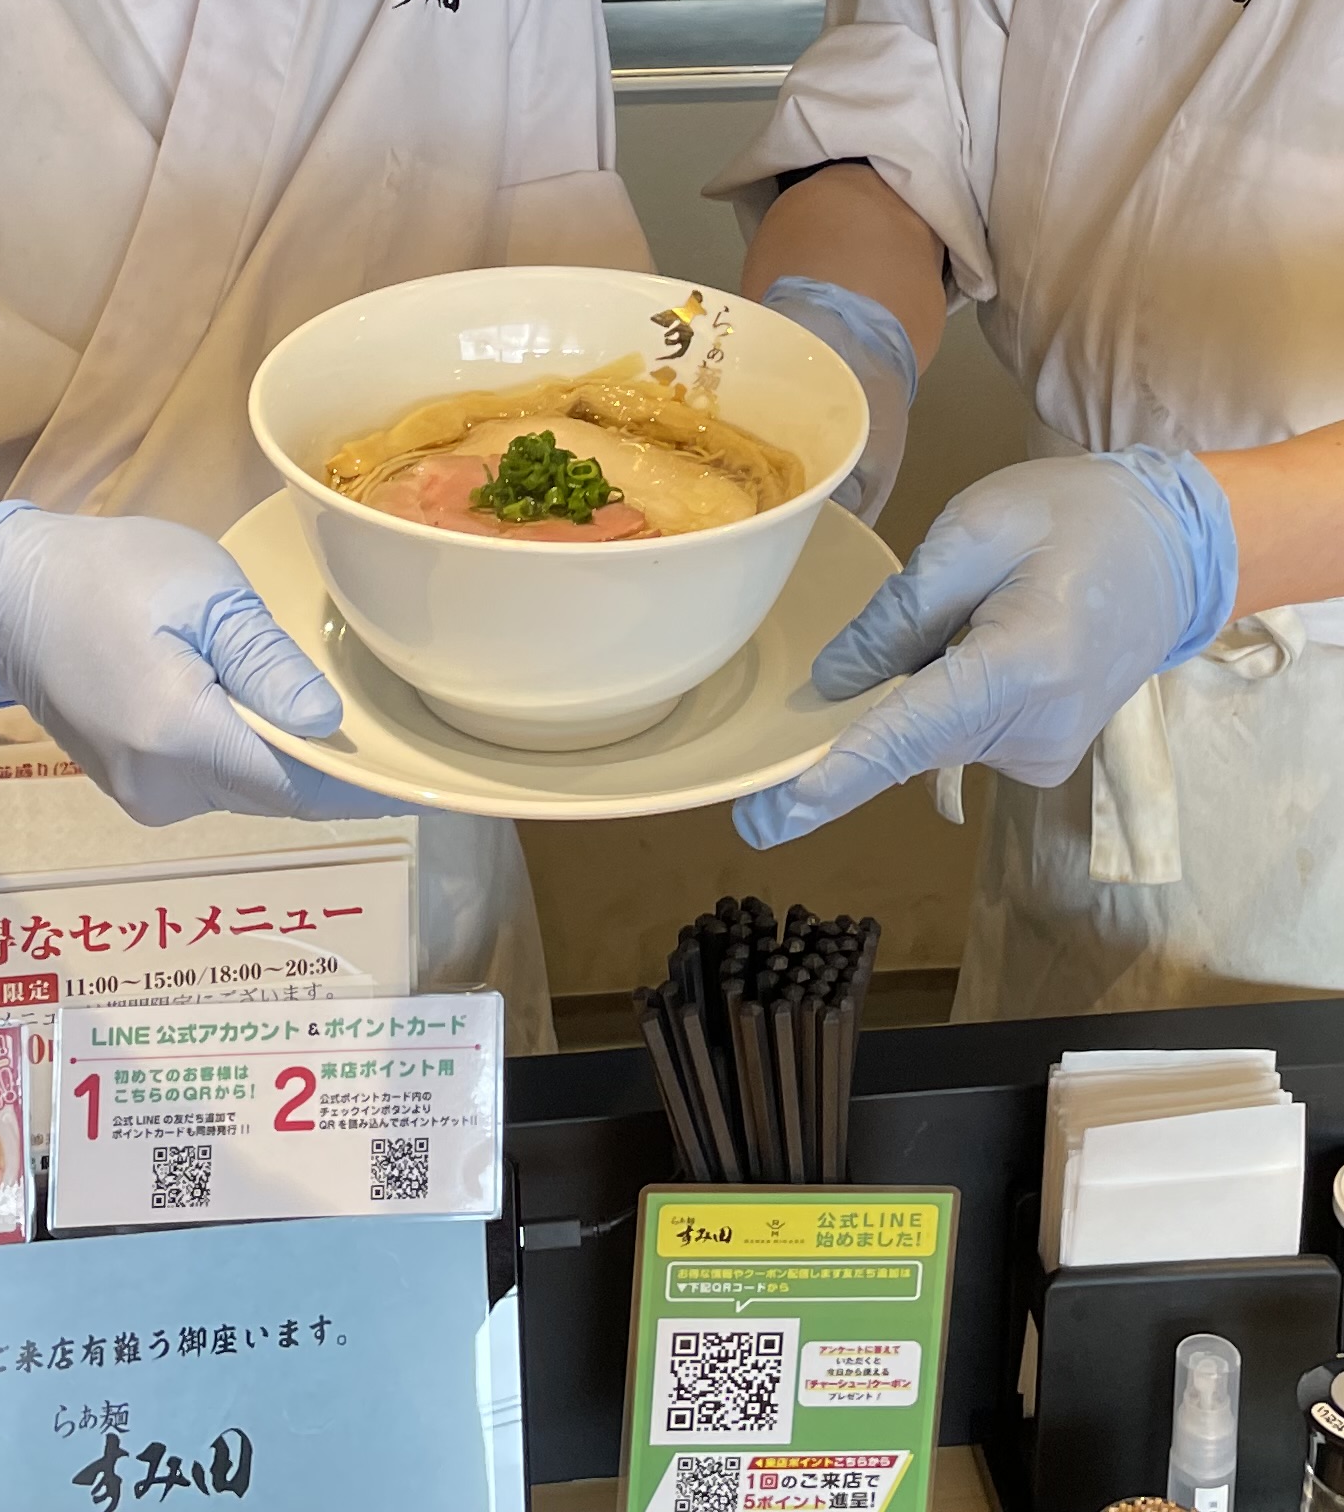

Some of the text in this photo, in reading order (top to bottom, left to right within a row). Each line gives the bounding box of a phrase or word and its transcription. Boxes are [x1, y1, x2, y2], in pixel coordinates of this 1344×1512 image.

[91, 1014, 467, 1046] LINE 公式アカウント & ポイントカード
[73, 1065, 250, 1141] 1 初めてのお客様は
[113, 1083, 256, 1105] こちらのQRから!
[273, 1059, 455, 1132] 2 来店ポイント用
[112, 1115, 134, 1127] 公式
[136, 1114, 161, 1126] LINE
[318, 1119, 336, 1131] QR
[817, 1211, 923, 1230] 公式LINE
[816, 1231, 922, 1249] 始めました!
[746, 1471, 881, 1490] 1回のご来店で
[743, 1491, 876, 1510] 5ポイント進呈!
